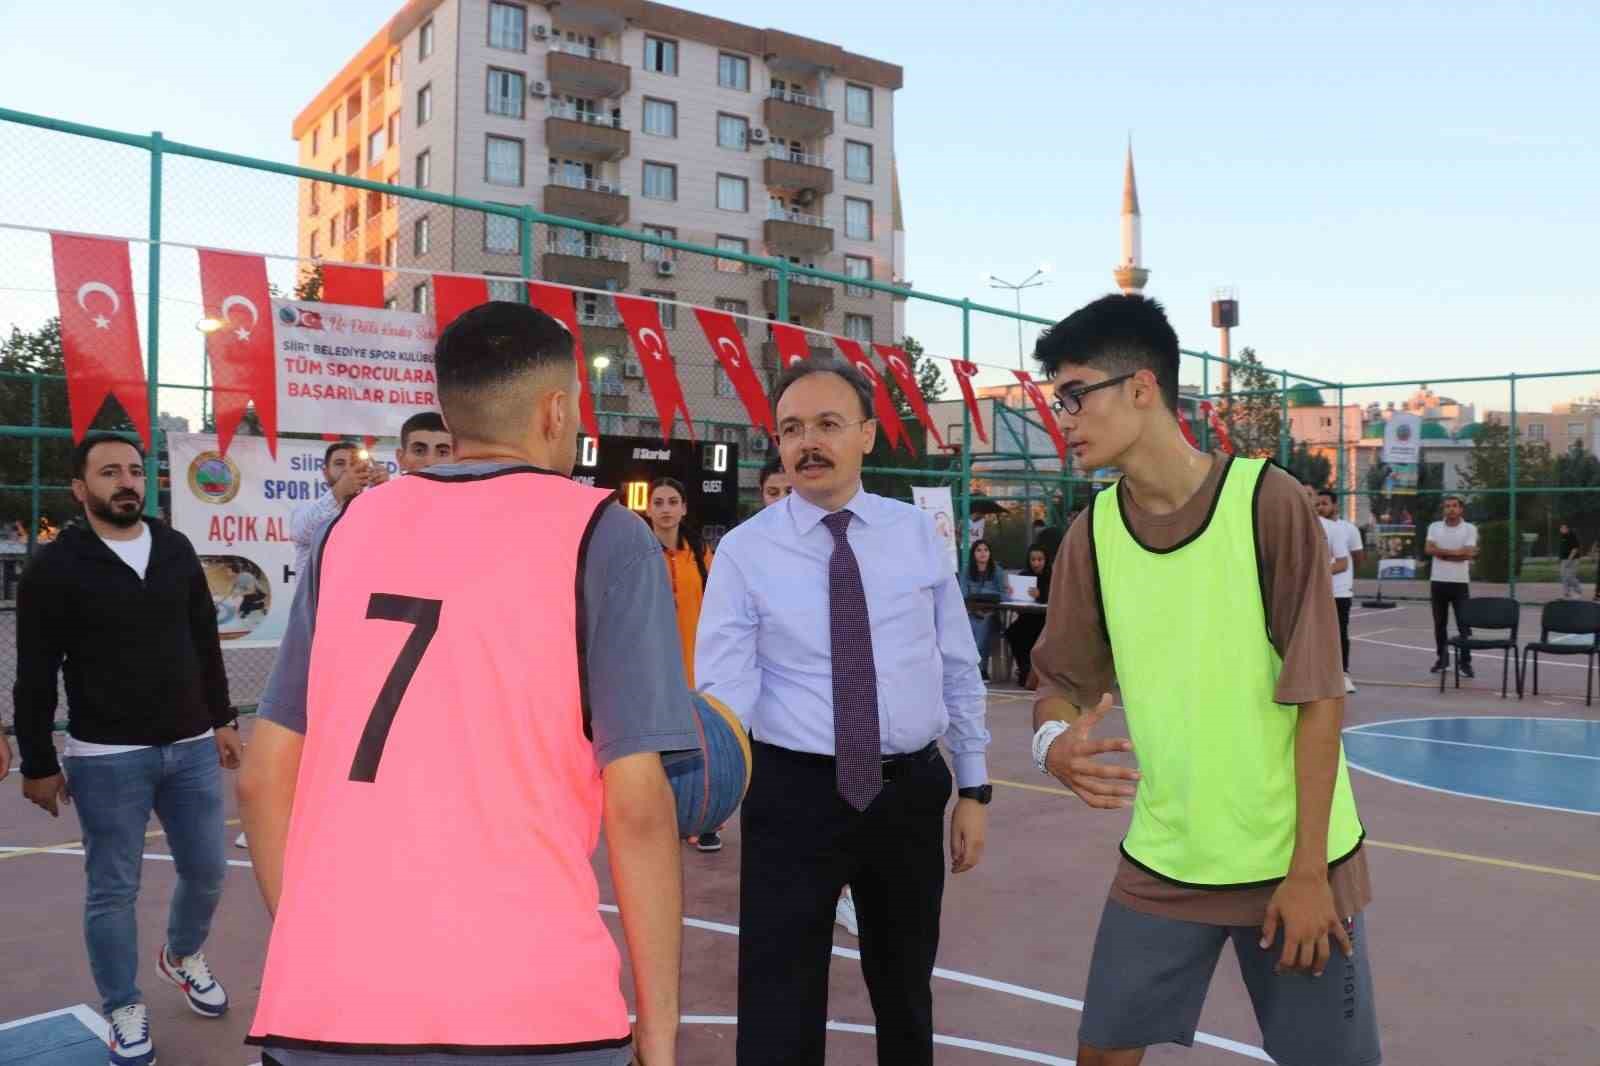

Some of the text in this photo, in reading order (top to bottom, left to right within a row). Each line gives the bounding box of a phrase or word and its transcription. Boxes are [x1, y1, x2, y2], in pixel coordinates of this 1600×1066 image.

[313, 343, 367, 358] BELEDİYE
[369, 349, 396, 361] SPOR
[285, 356, 435, 384] TÜM SPORCULARA
[288, 382, 384, 403] BAŞARILAR
[713, 444, 728, 472] 0
[264, 480, 310, 500] SPOR
[628, 481, 648, 511] 10
[208, 515, 258, 547] AÇIK
[348, 593, 443, 783] 7
